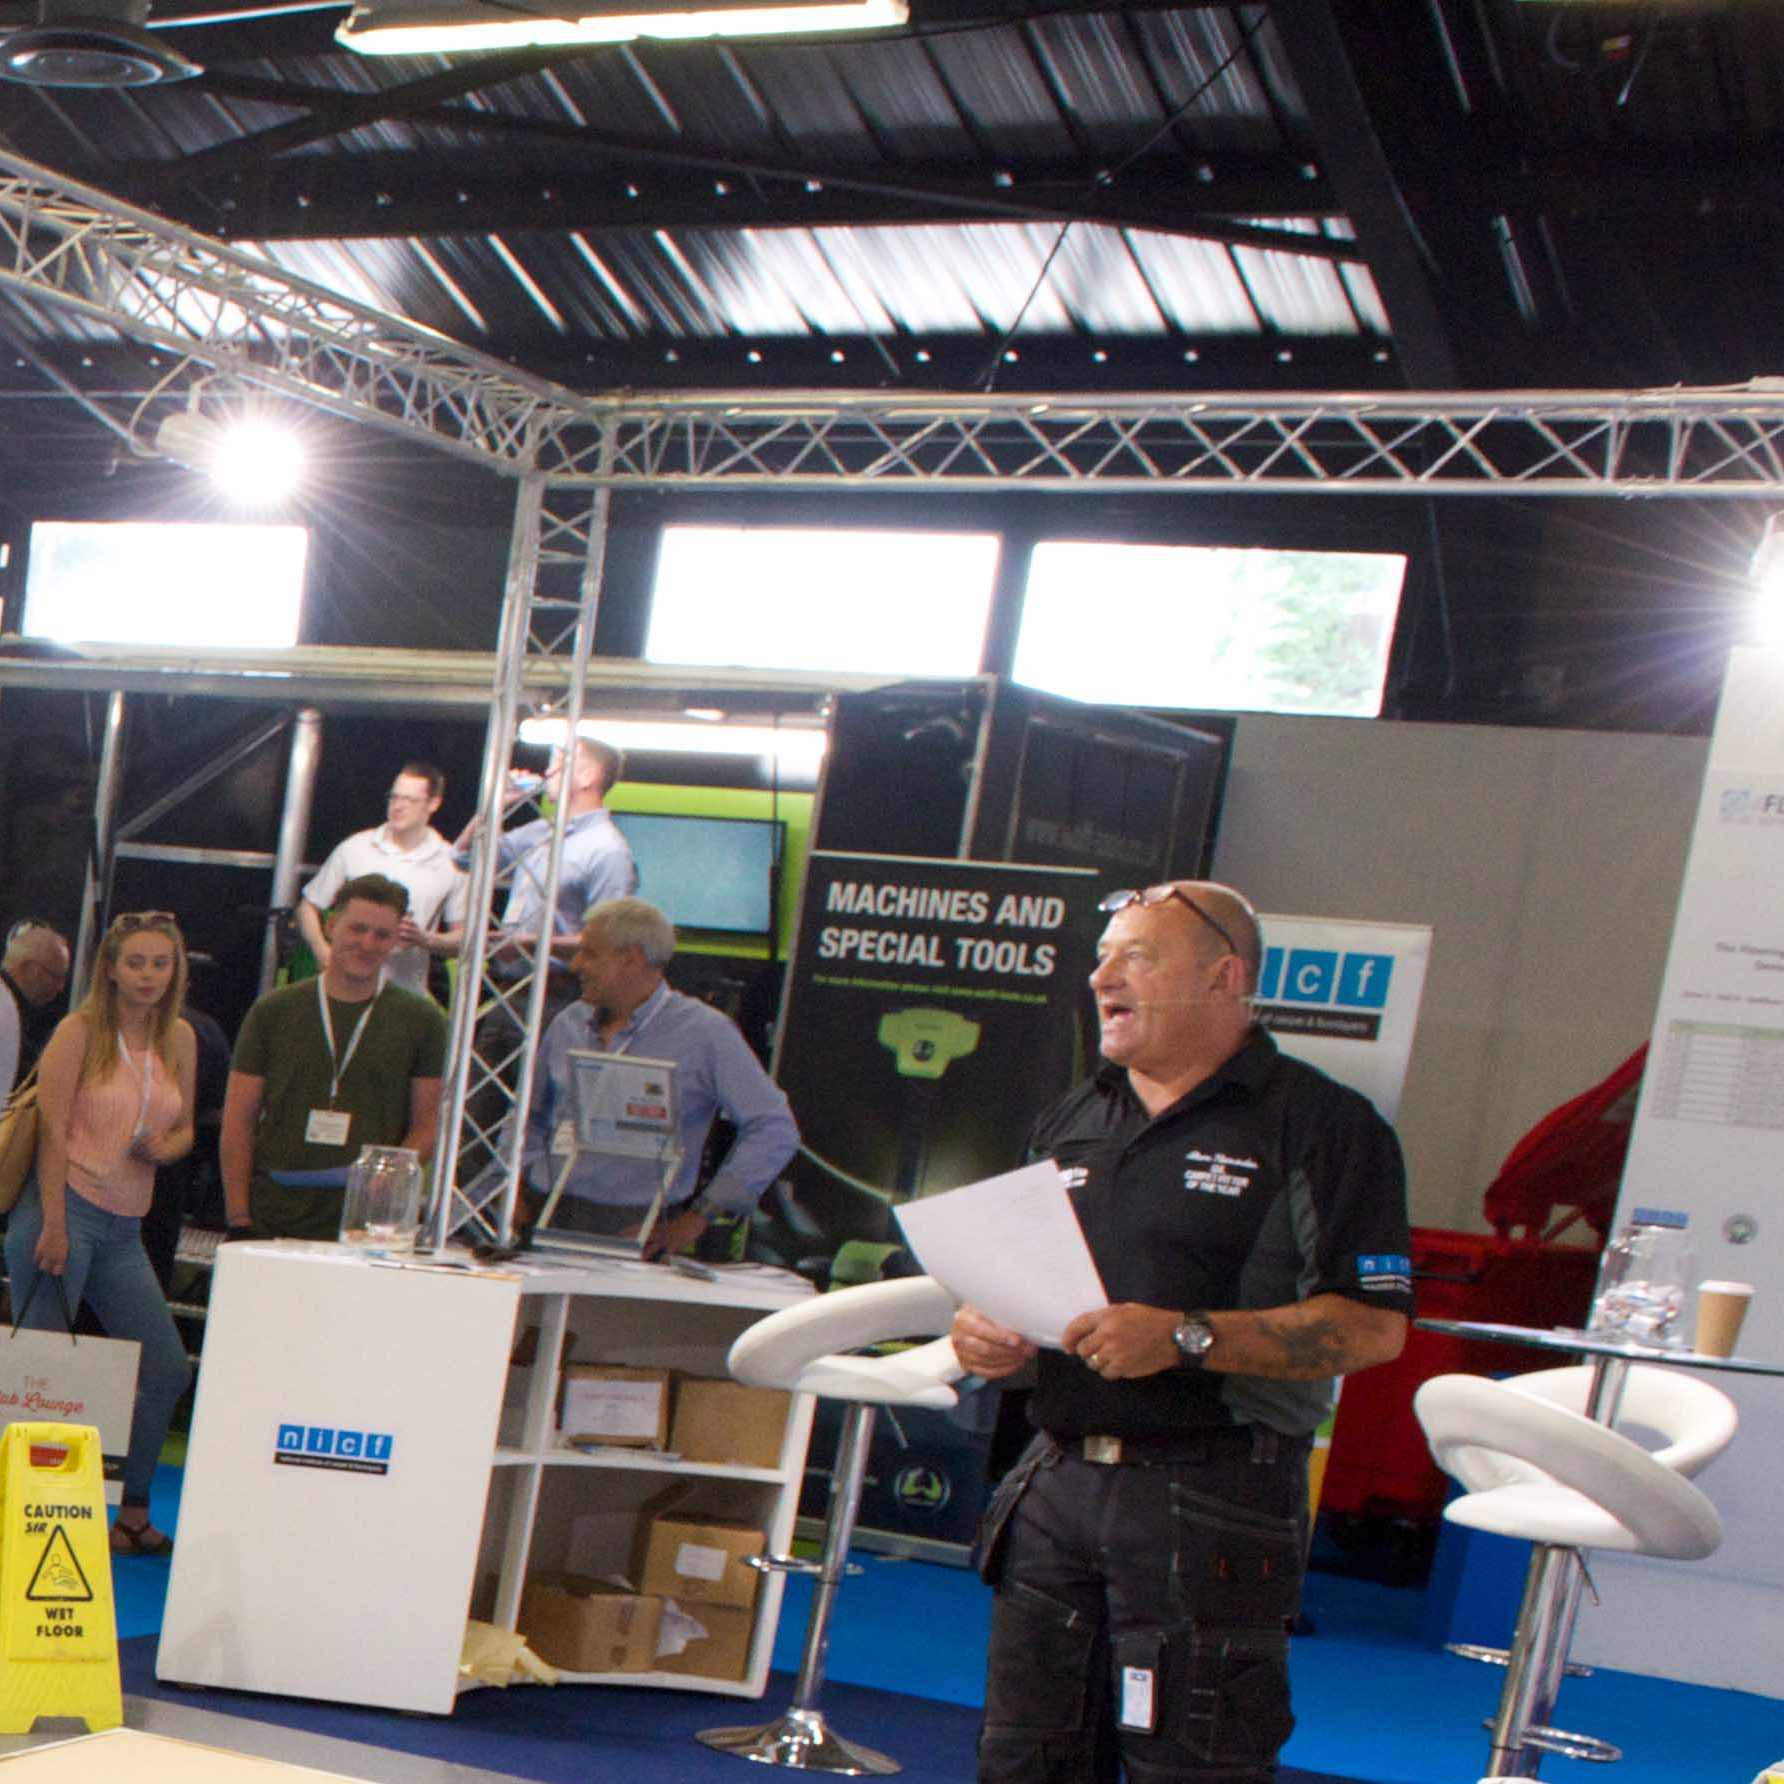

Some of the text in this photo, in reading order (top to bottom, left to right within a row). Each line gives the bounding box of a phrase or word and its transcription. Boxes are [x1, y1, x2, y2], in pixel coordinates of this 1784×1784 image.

[826, 881, 1066, 929] MACHINES AND
[818, 926, 1058, 977] SPECIAL TOOLS
[1297, 959, 1376, 999] cf
[23, 1375, 49, 1392] THE
[21, 1391, 85, 1416] Lounge
[283, 1430, 385, 1458] nicf
[23, 1504, 92, 1519] CAUTION
[45, 1607, 75, 1620] WET
[36, 1625, 84, 1637] FLOOR
